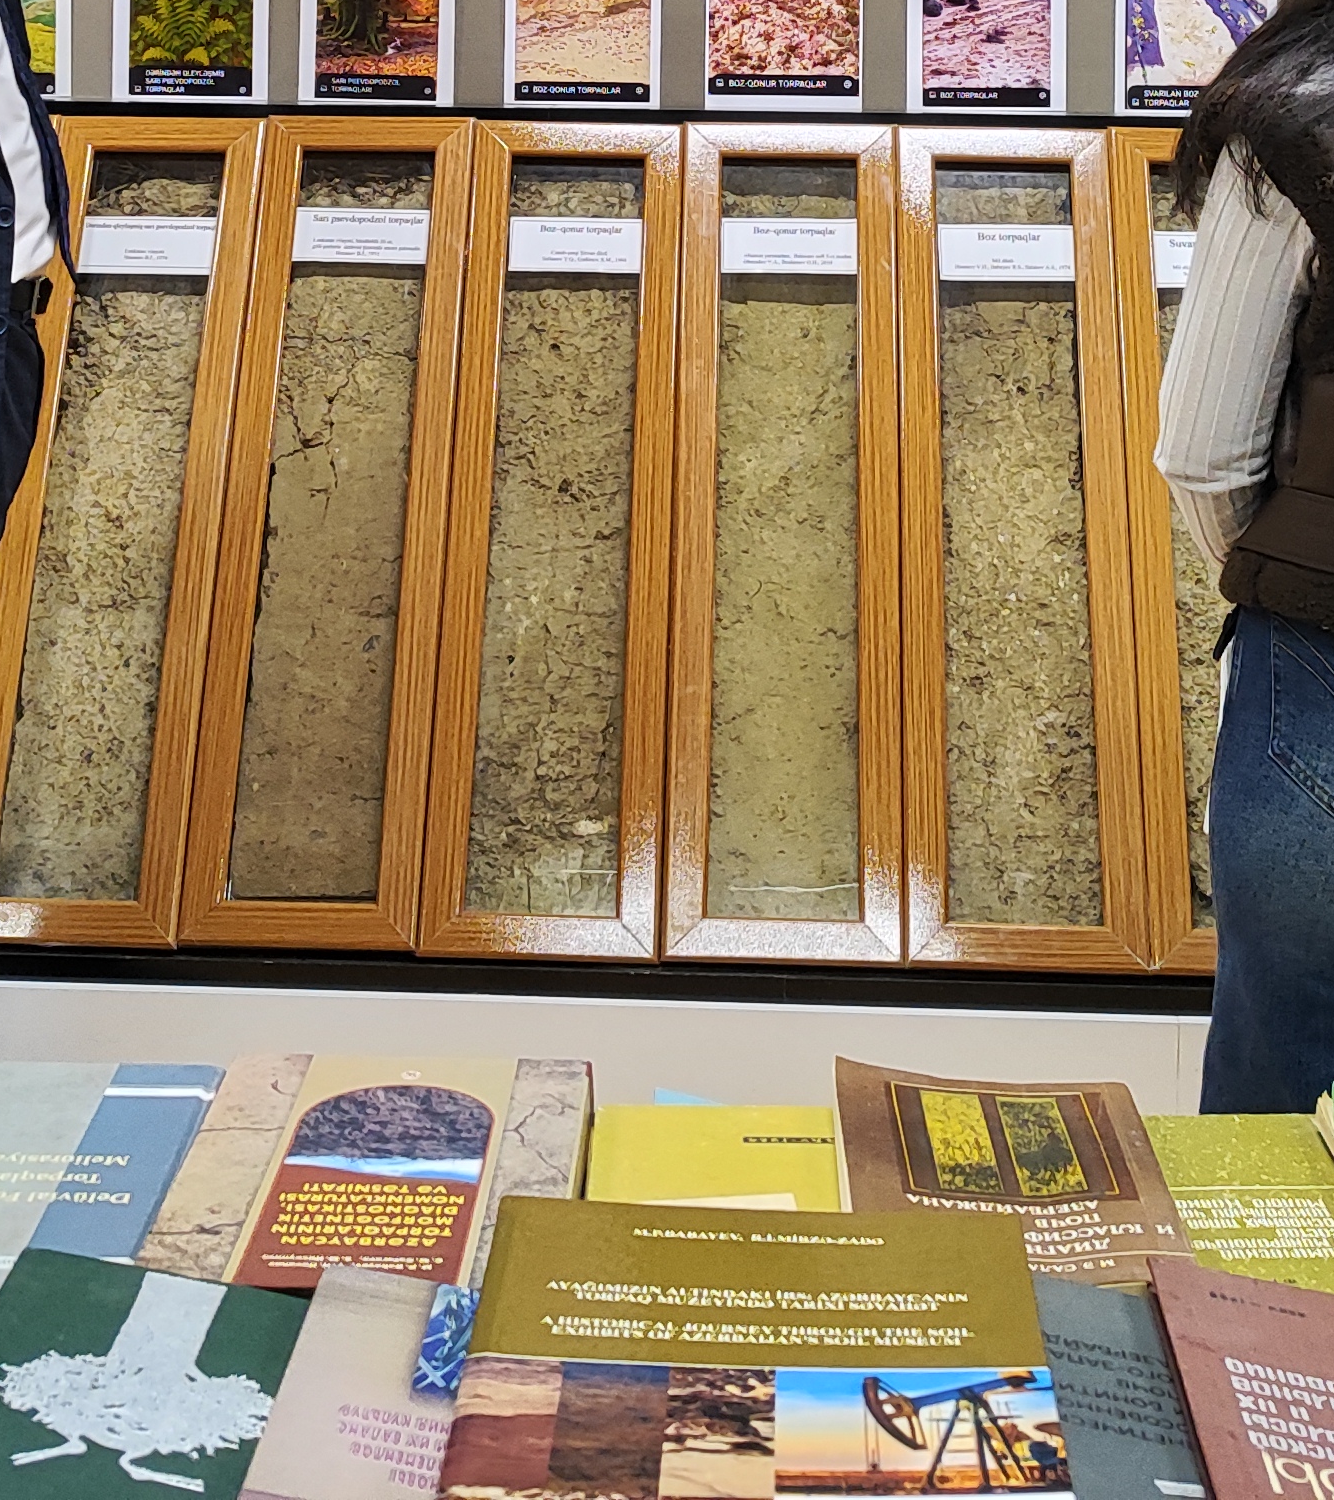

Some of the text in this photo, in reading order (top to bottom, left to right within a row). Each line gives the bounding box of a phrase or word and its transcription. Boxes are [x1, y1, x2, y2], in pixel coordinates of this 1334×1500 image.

[778, 79, 827, 88] TORPAQLAR
[977, 232, 1040, 242] Boz torpaqlar
[29, 1189, 131, 1205] Delüvial
[1034, 1212, 1102, 1229] ПОЧВ
[271, 1223, 452, 1237] TORPAQLARININ
[1234, 1393, 1310, 1421] и их
